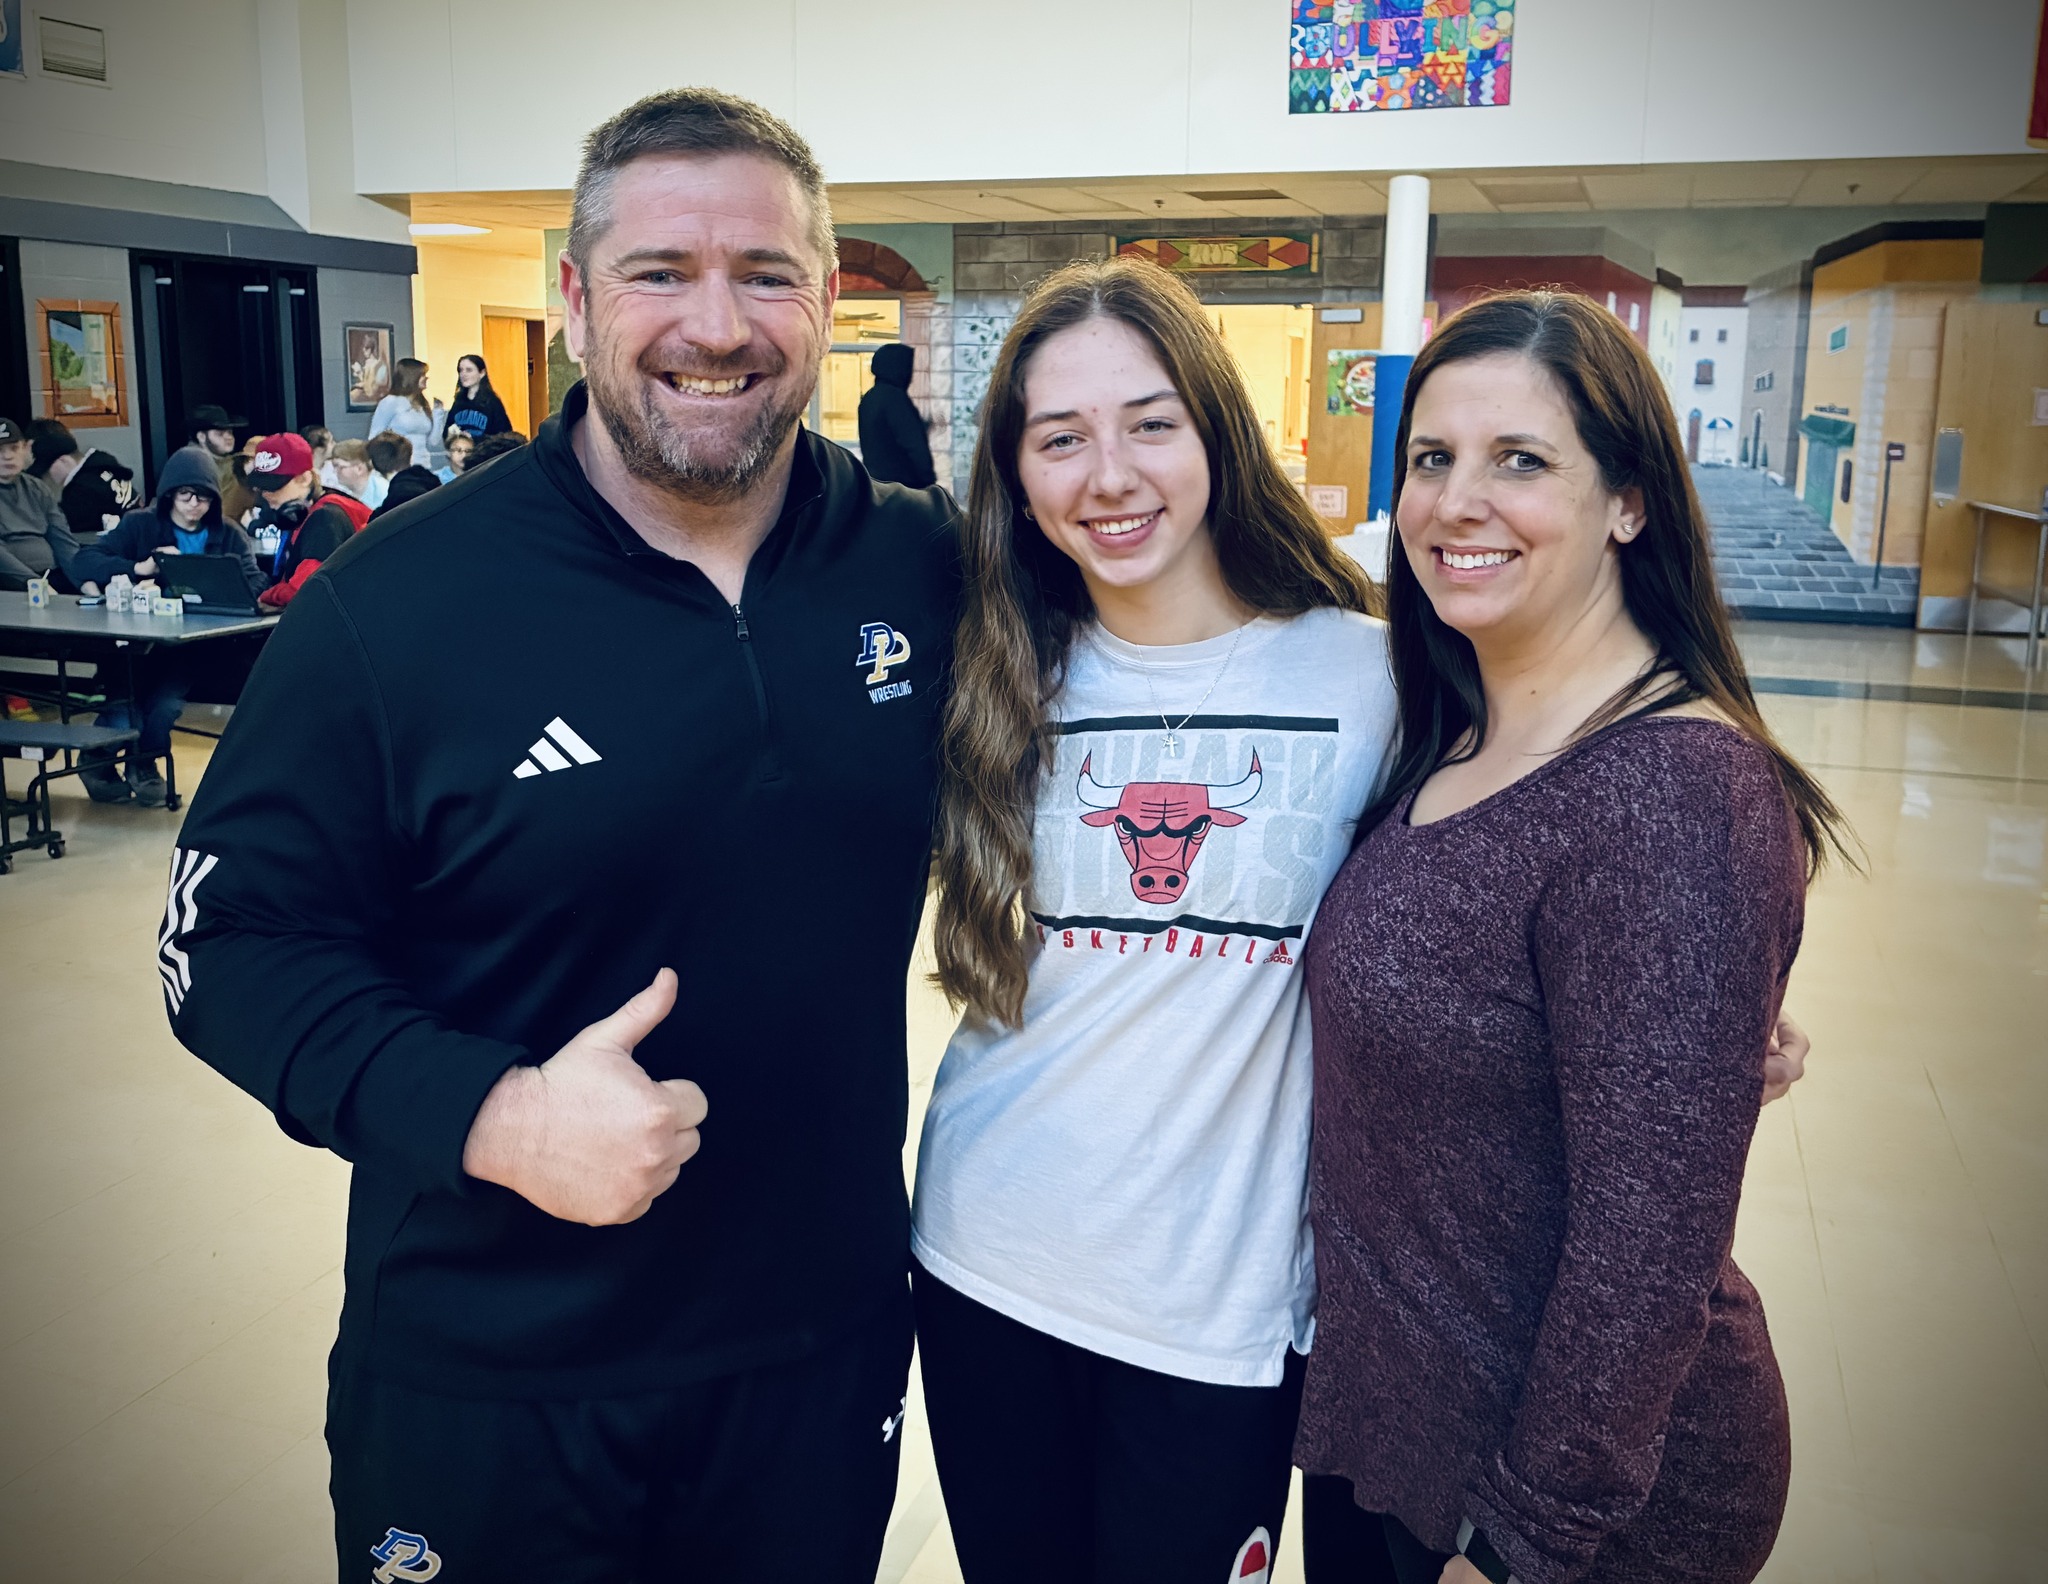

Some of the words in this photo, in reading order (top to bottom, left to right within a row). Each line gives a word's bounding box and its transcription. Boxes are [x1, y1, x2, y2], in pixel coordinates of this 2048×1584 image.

[1304, 14, 1501, 58] BULLYING
[868, 679, 913, 704] WRESTLING
[1037, 924, 1254, 965] SKETBALL
